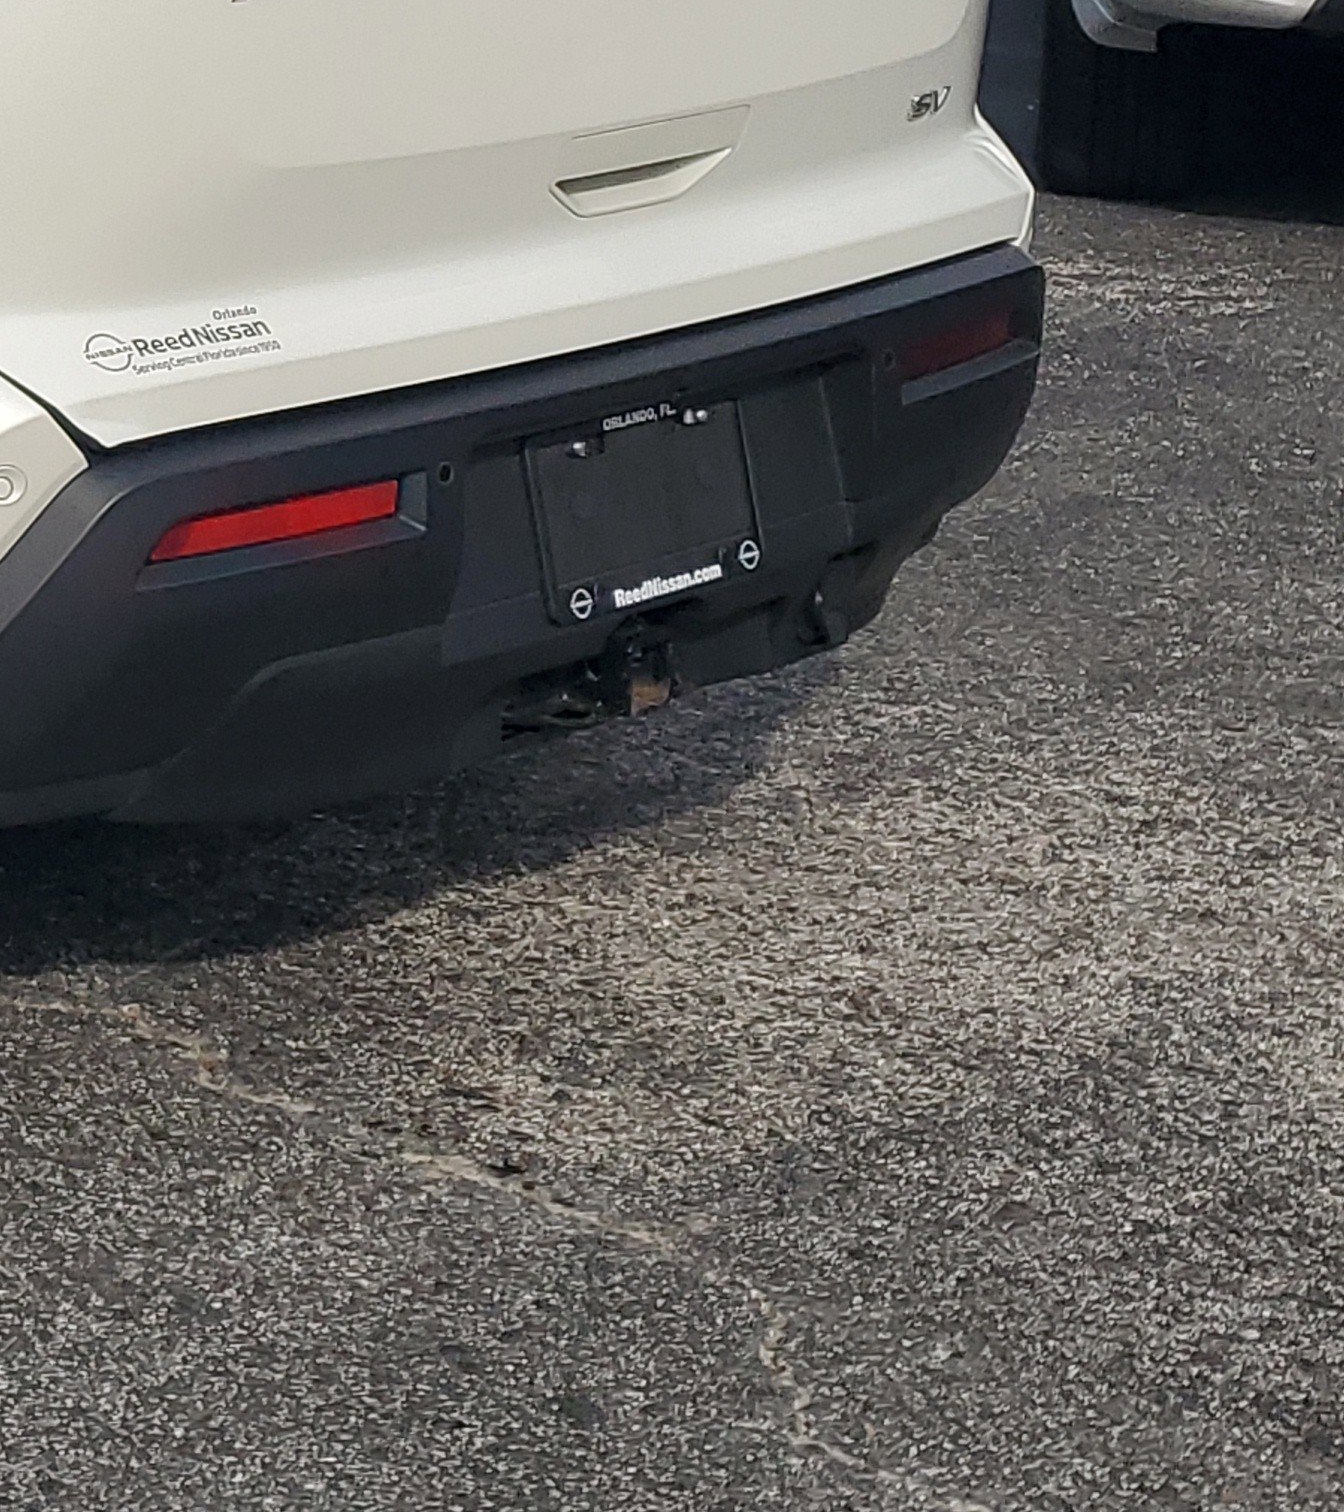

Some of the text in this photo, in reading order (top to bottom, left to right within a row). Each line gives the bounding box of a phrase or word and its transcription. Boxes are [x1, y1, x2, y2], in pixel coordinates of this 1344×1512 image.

[907, 85, 952, 122] SV
[212, 305, 258, 321] Orlando
[85, 344, 133, 361] NISSAN
[131, 359, 171, 375] Serving
[169, 353, 203, 368] Central
[202, 347, 235, 362] Florida
[602, 406, 658, 431] ORLANDO,
[613, 563, 723, 608] ReedNissan.com
